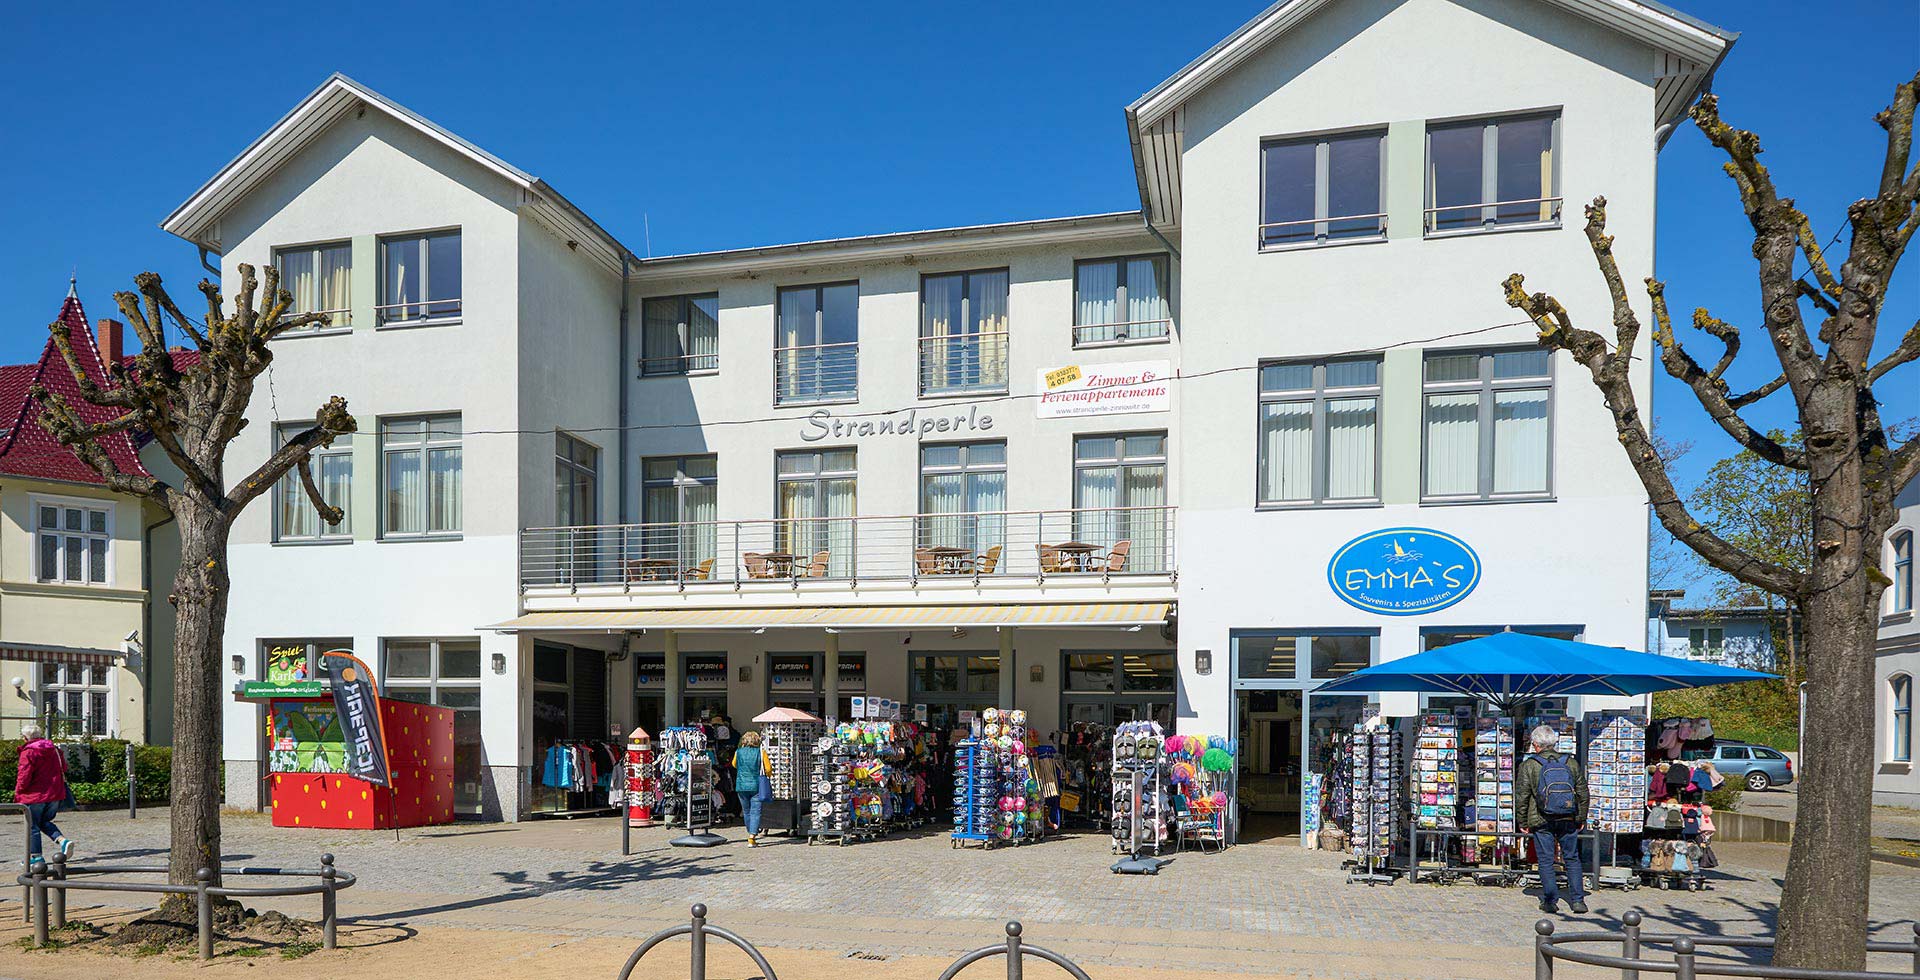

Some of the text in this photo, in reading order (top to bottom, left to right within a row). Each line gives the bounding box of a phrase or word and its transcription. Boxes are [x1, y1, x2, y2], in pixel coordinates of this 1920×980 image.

[1057, 377, 1065, 385] 07
[1067, 373, 1077, 382] 58
[1086, 371, 1156, 387] Zimmer &
[1041, 386, 1166, 403] Ferienappartements
[800, 405, 993, 442] Strandperle
[1359, 592, 1393, 607] Souvenirs
[1402, 590, 1451, 608] Spezialitäten
